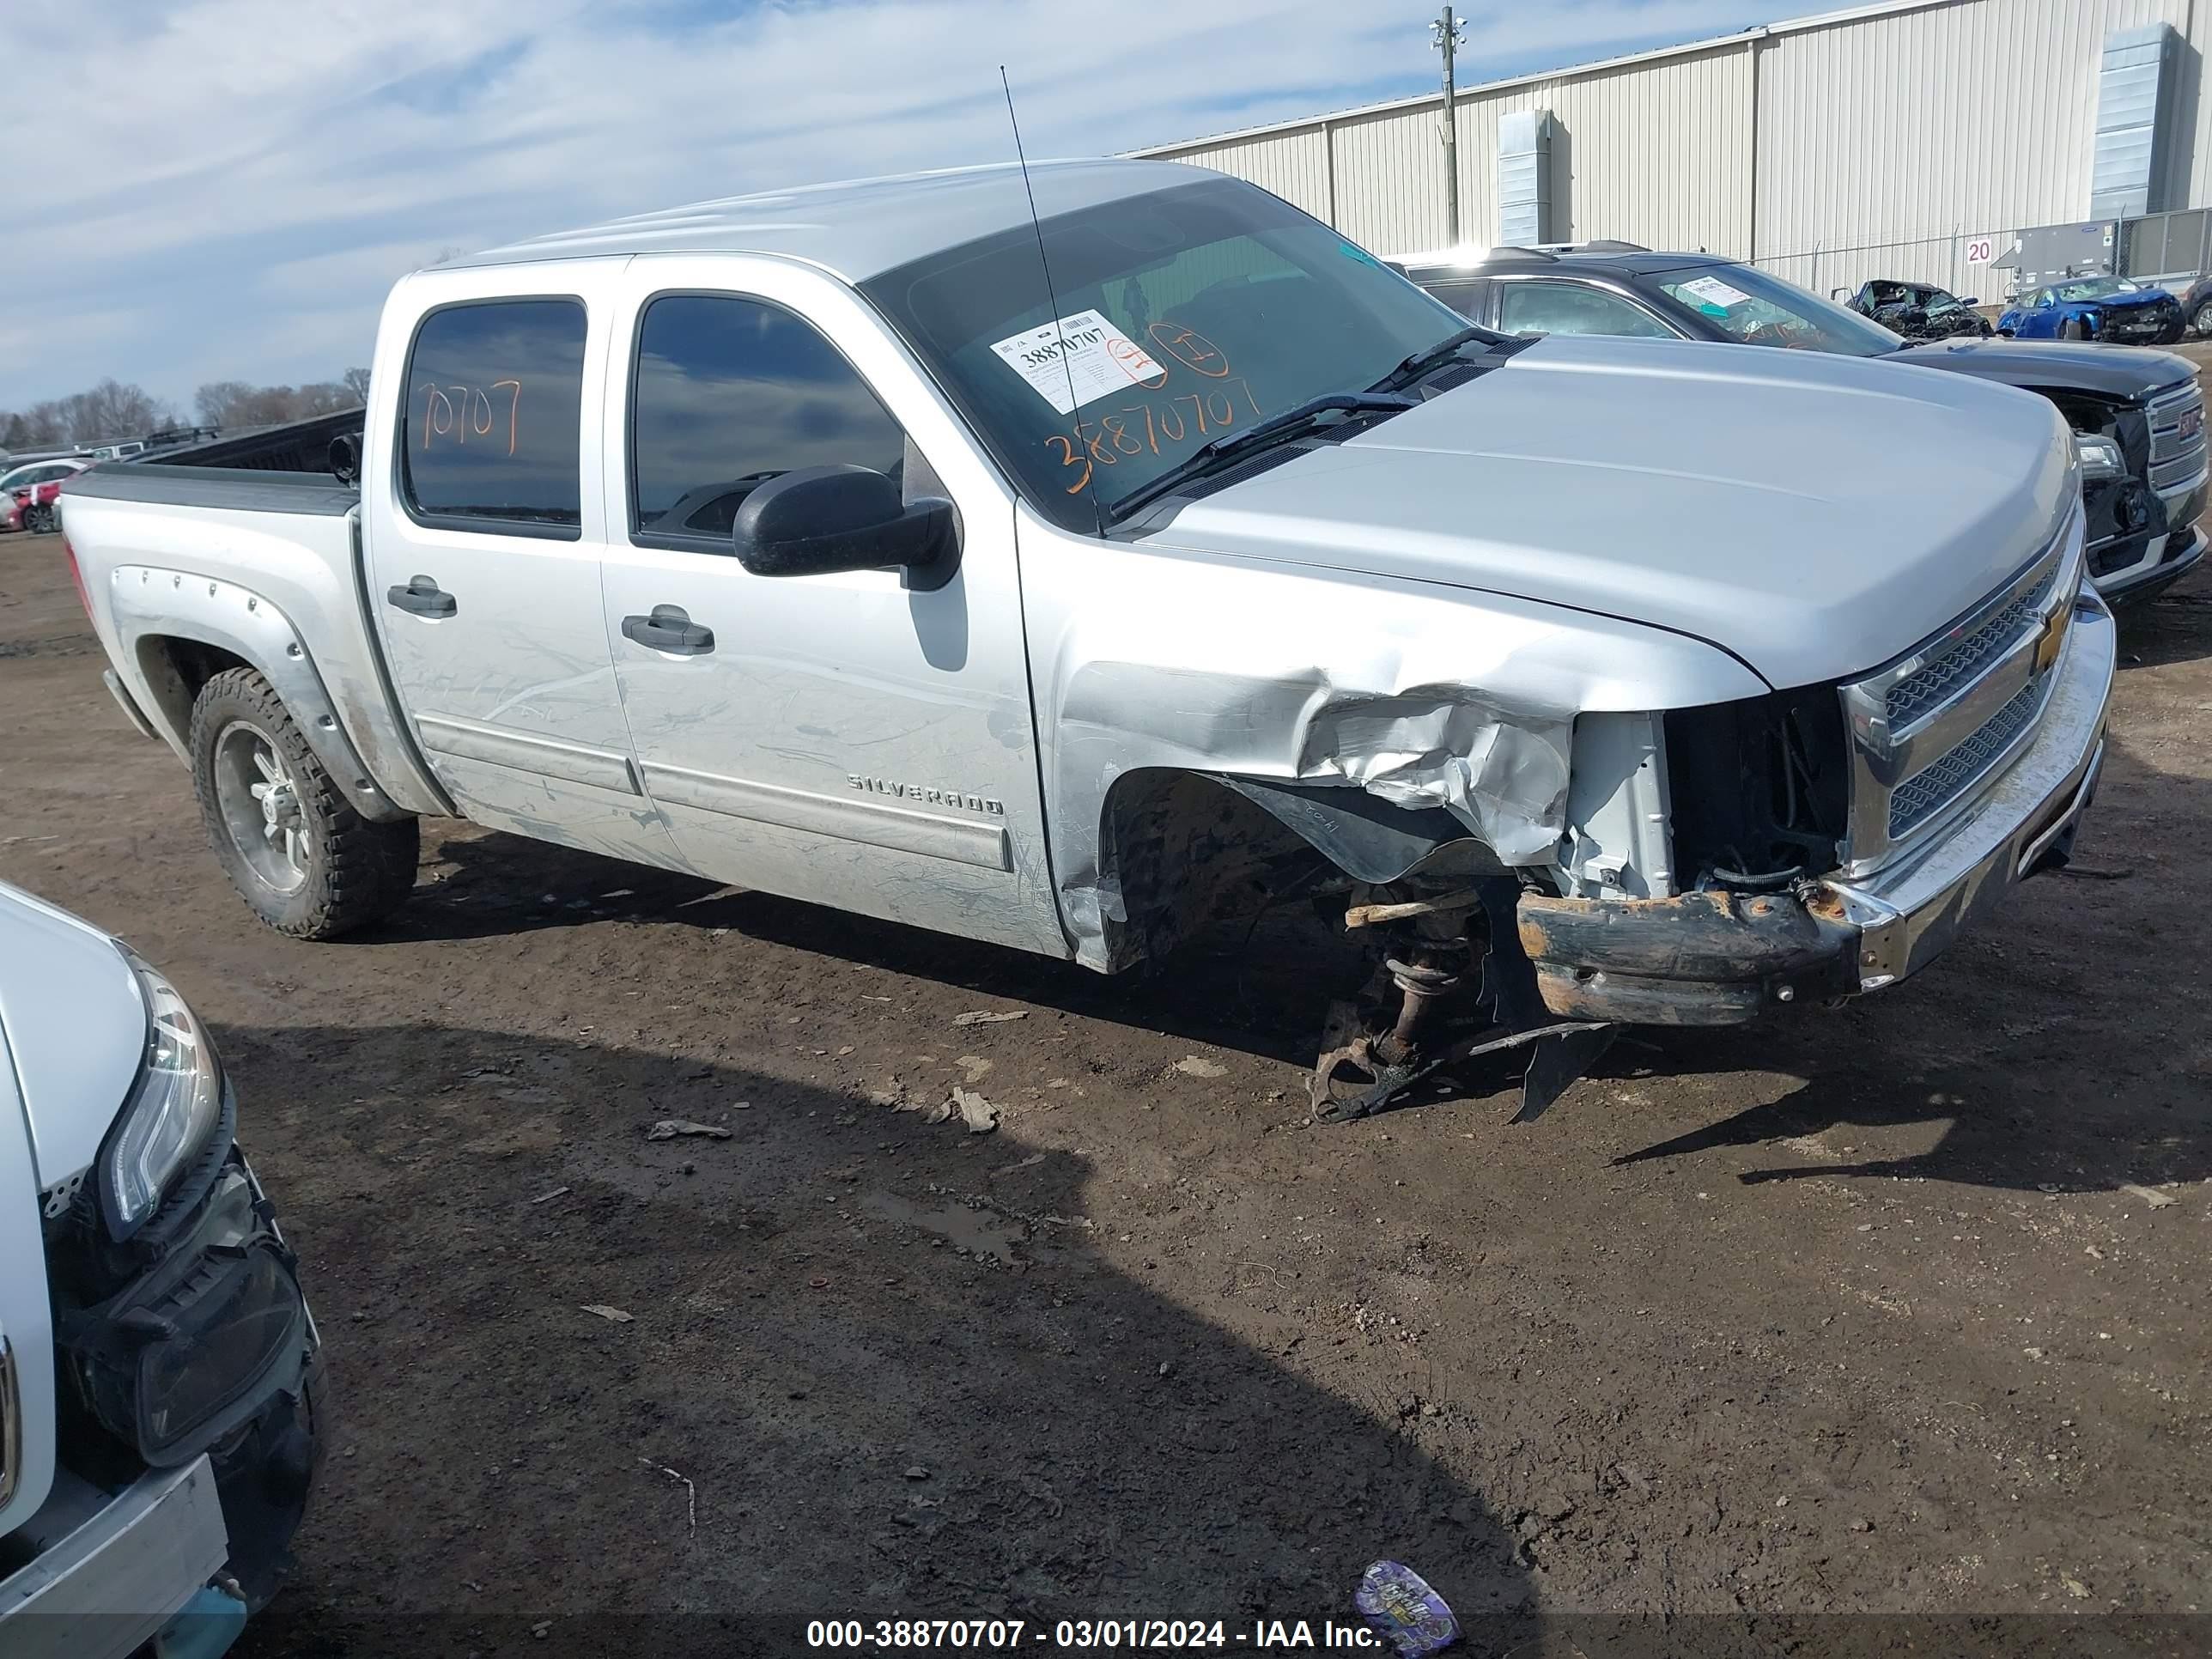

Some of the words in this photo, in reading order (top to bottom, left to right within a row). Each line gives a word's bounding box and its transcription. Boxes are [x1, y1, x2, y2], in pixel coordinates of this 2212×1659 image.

[1968, 242, 1990, 261] 20
[1020, 327, 1107, 368] 38870707
[418, 380, 520, 457] 70707
[1044, 377, 1261, 495] 38870707
[847, 774, 1004, 815] SILVERADO
